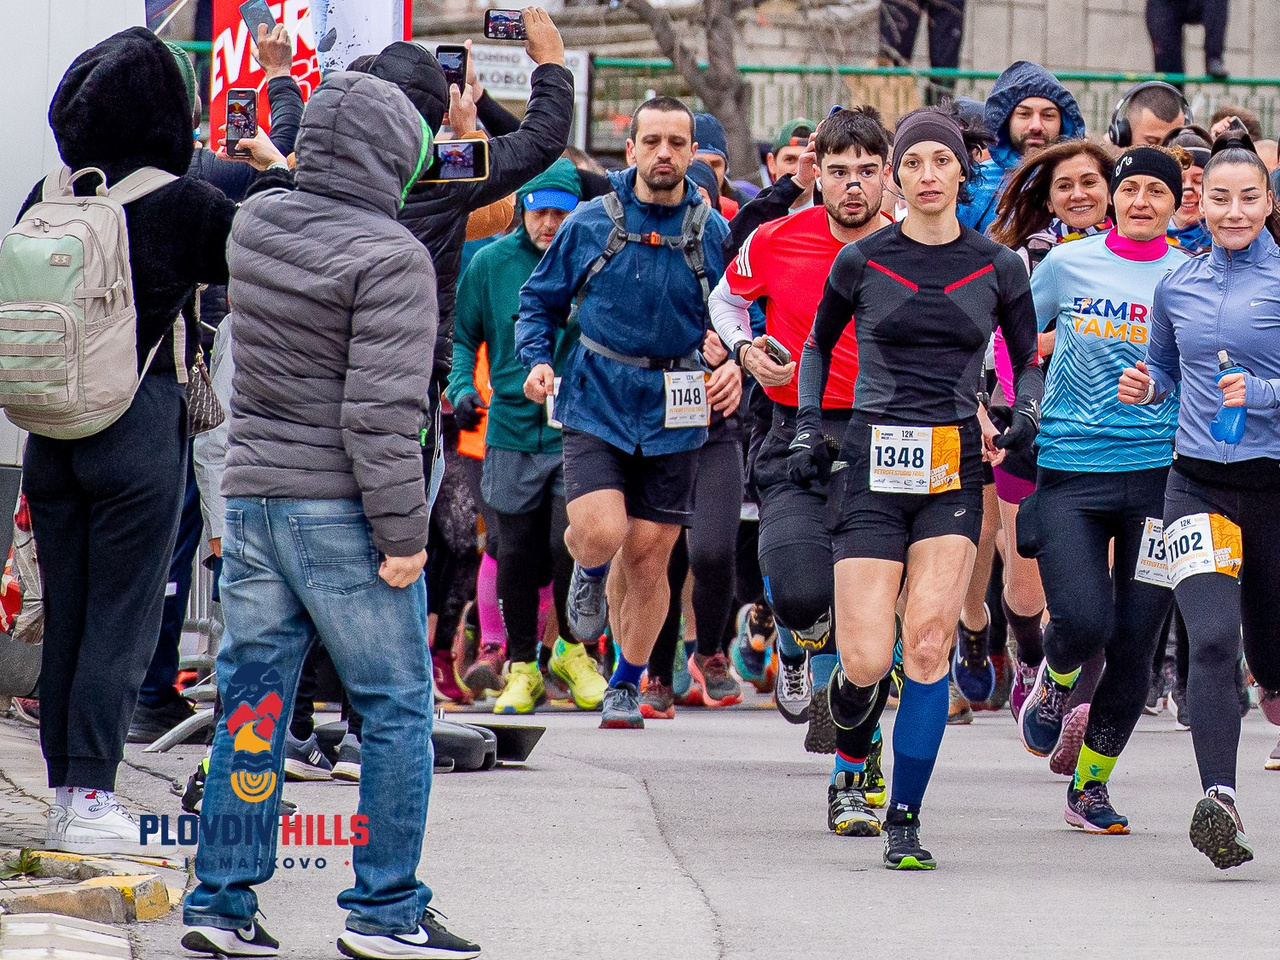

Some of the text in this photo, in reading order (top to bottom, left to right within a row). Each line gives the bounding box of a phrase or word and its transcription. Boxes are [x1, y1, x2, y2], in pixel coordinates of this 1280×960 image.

[671, 387, 702, 406] 1148
[875, 446, 924, 468] 1348
[1168, 532, 1203, 563] 1102
